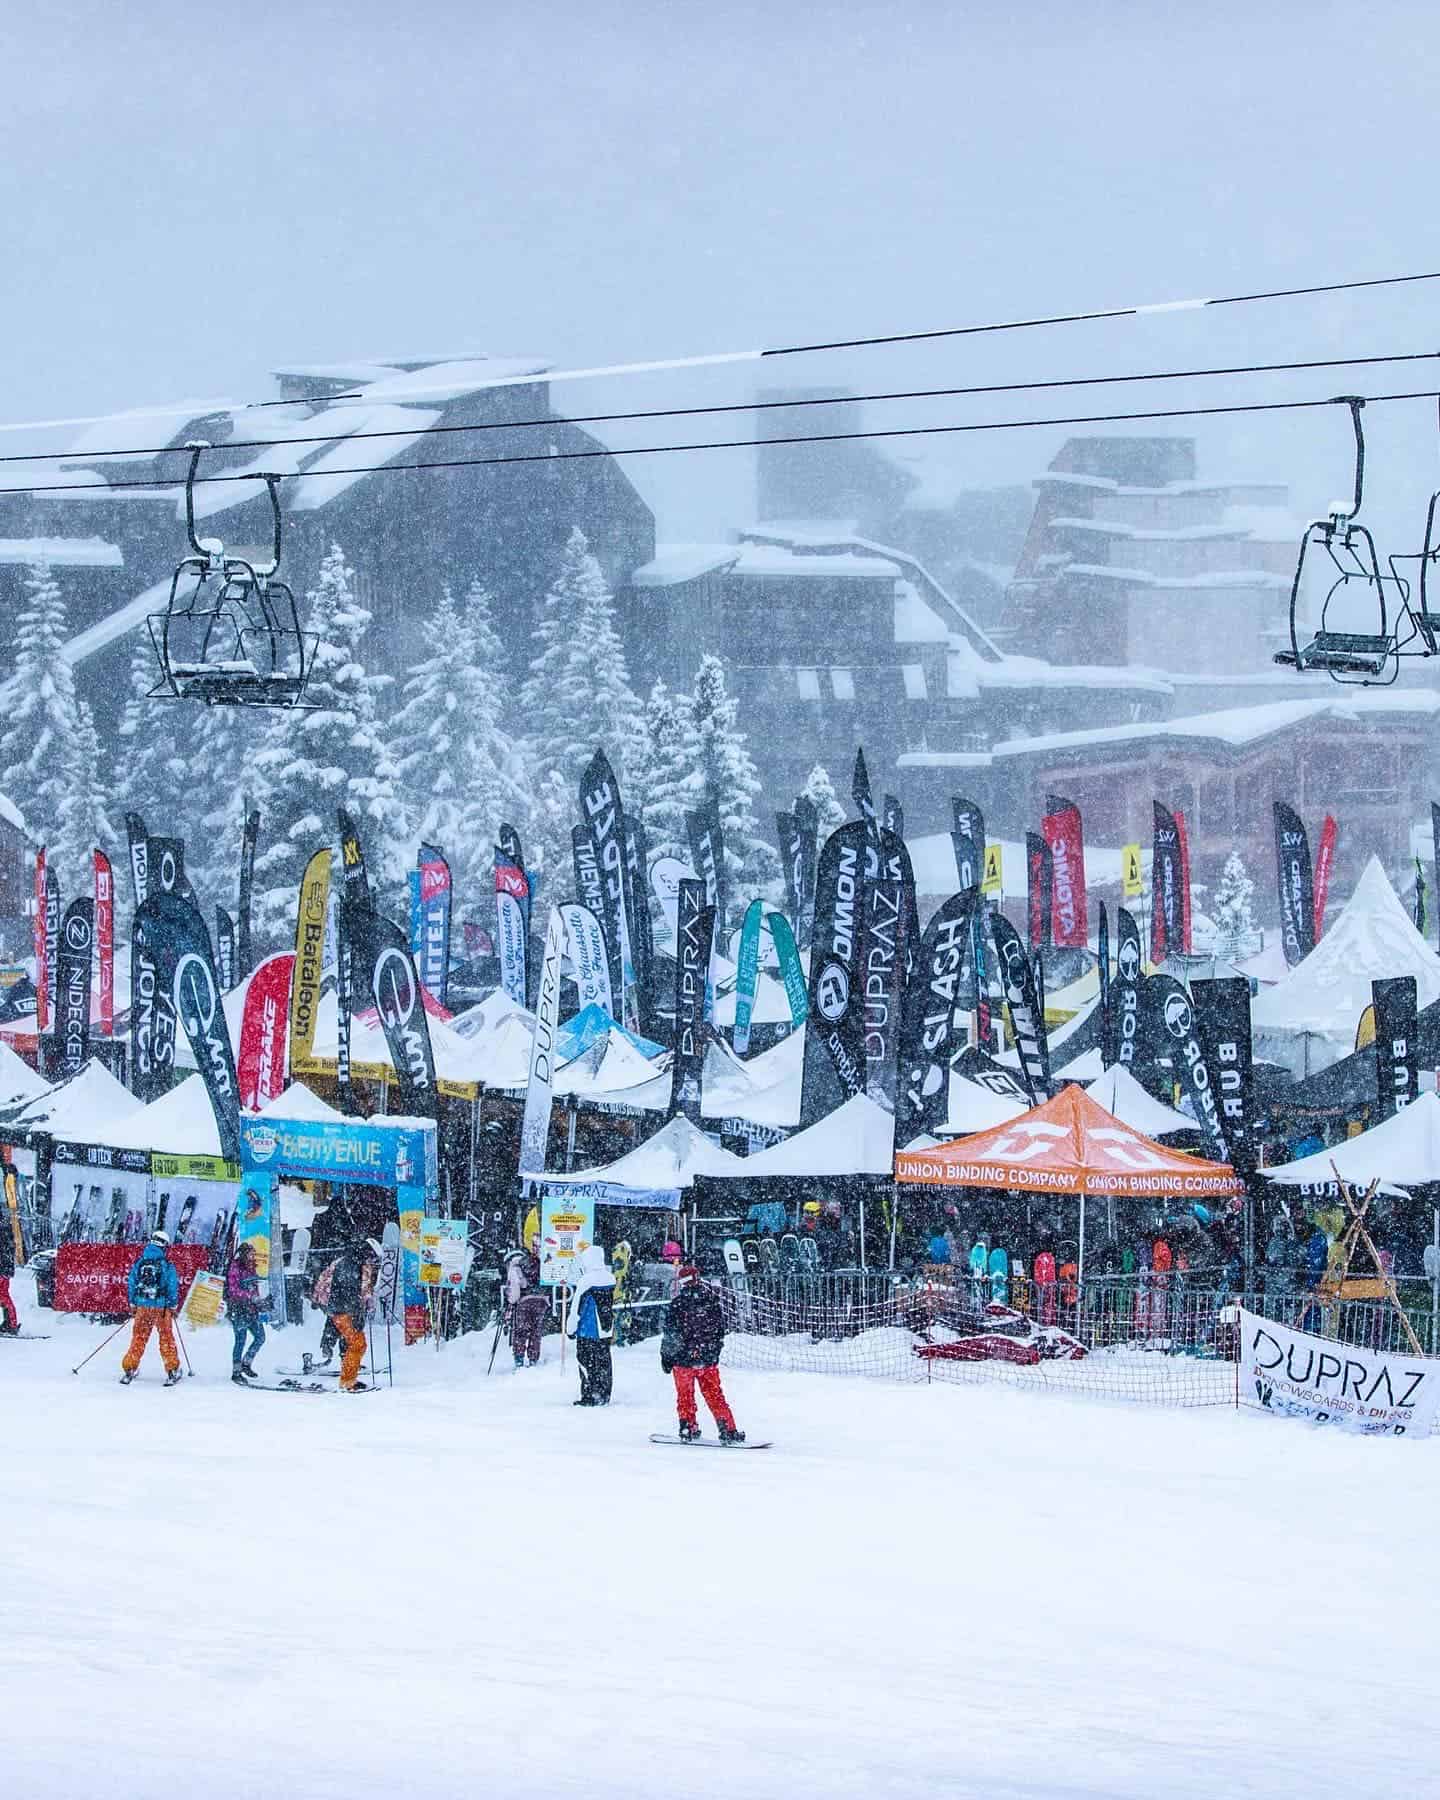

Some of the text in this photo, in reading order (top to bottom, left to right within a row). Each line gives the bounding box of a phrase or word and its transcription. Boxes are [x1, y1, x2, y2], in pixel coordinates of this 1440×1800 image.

[297, 923, 323, 1037] Bataleon
[534, 926, 559, 1084] DUPRAZ
[682, 888, 699, 1056] DUPRAZ
[866, 889, 900, 1060] DUPRAZ
[923, 918, 963, 1050] SLASH
[66, 967, 84, 1070] NIDECKER
[1219, 1043, 1244, 1118] BUR
[282, 1135, 381, 1166] BIENVENUE
[898, 1162, 1077, 1188] UNION BINDING COMPANY
[1087, 1175, 1128, 1189] UNION
[1130, 1177, 1182, 1191] BINDING
[66, 1274, 128, 1286] SAVOIE MO
[1253, 1329, 1425, 1408] DUPRAZ
[1264, 1376, 1354, 1412] SNOWBOARDS
